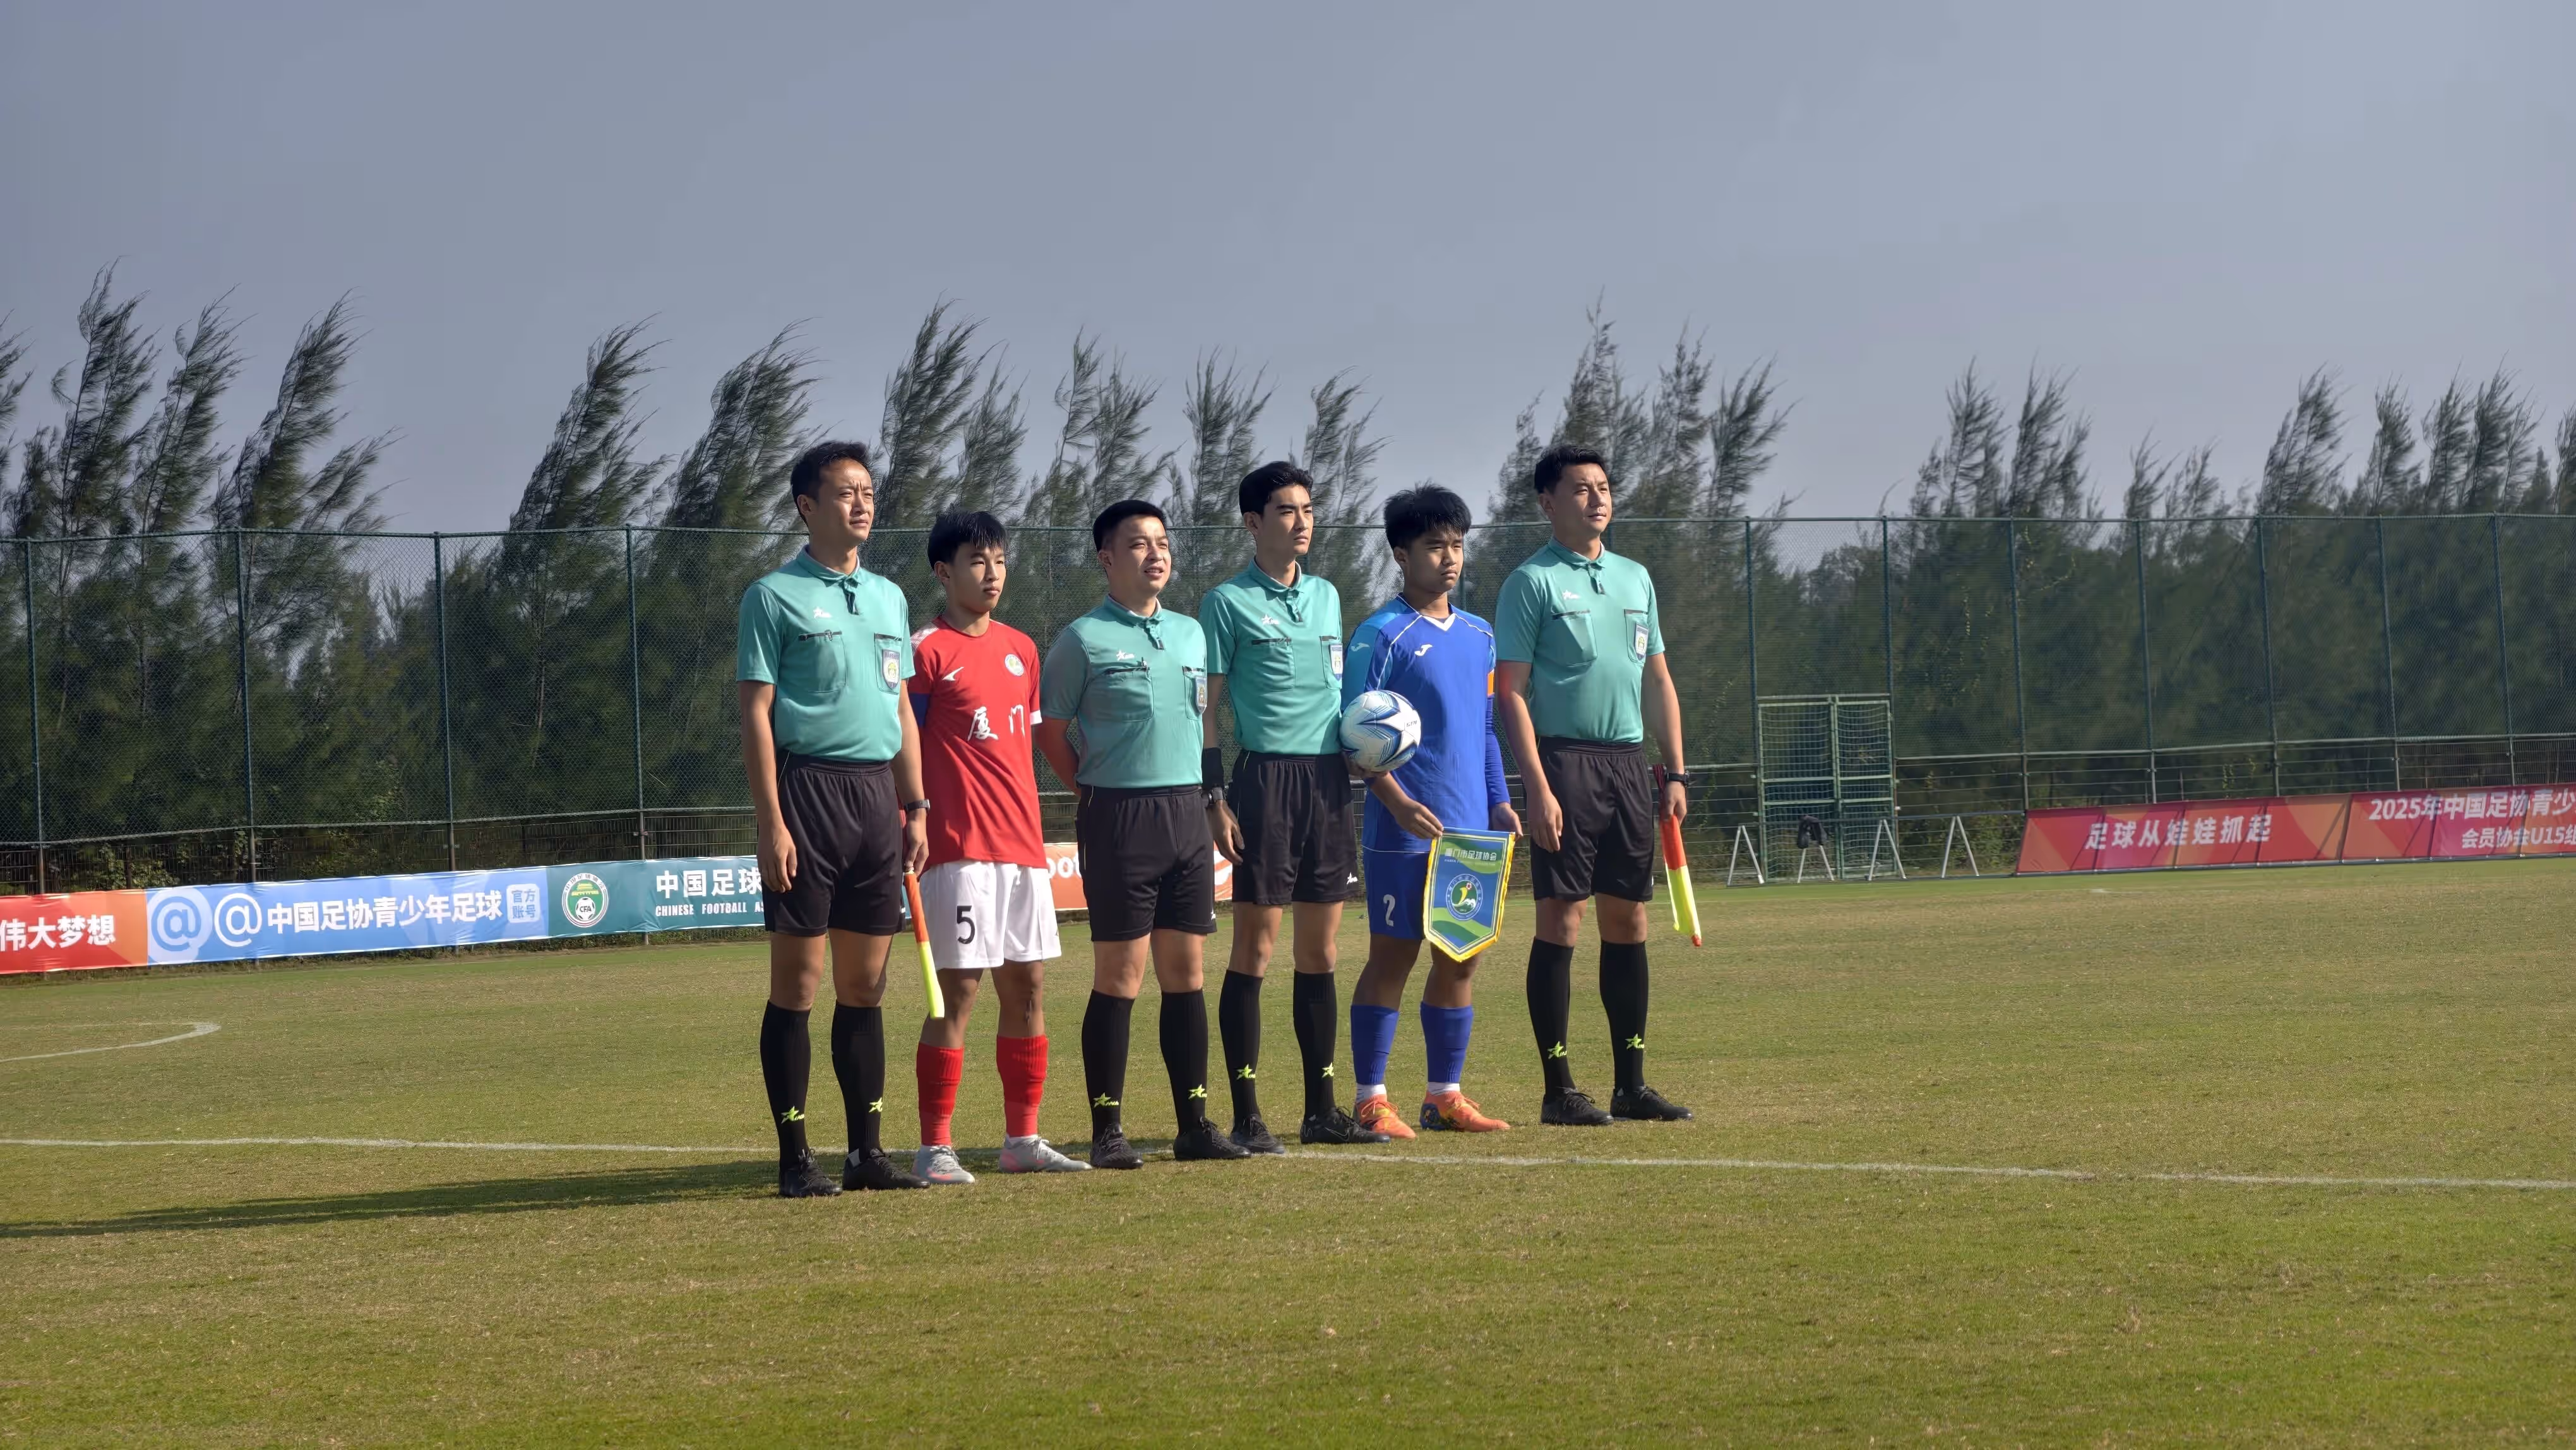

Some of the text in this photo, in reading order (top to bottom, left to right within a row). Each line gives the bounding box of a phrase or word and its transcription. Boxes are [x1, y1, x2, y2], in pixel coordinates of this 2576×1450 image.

[2084, 814, 2272, 850] 足球从娃娃抓起
[511, 889, 537, 903] 官方
[656, 866, 762, 899] 中国足球
[512, 904, 537, 920] 账号
[655, 904, 694, 916] CHINESE
[701, 902, 748, 914] FOOTBALL
[956, 905, 975, 945] 5
[1383, 894, 1396, 927] 2
[0, 914, 116, 952] 伟大梦想
